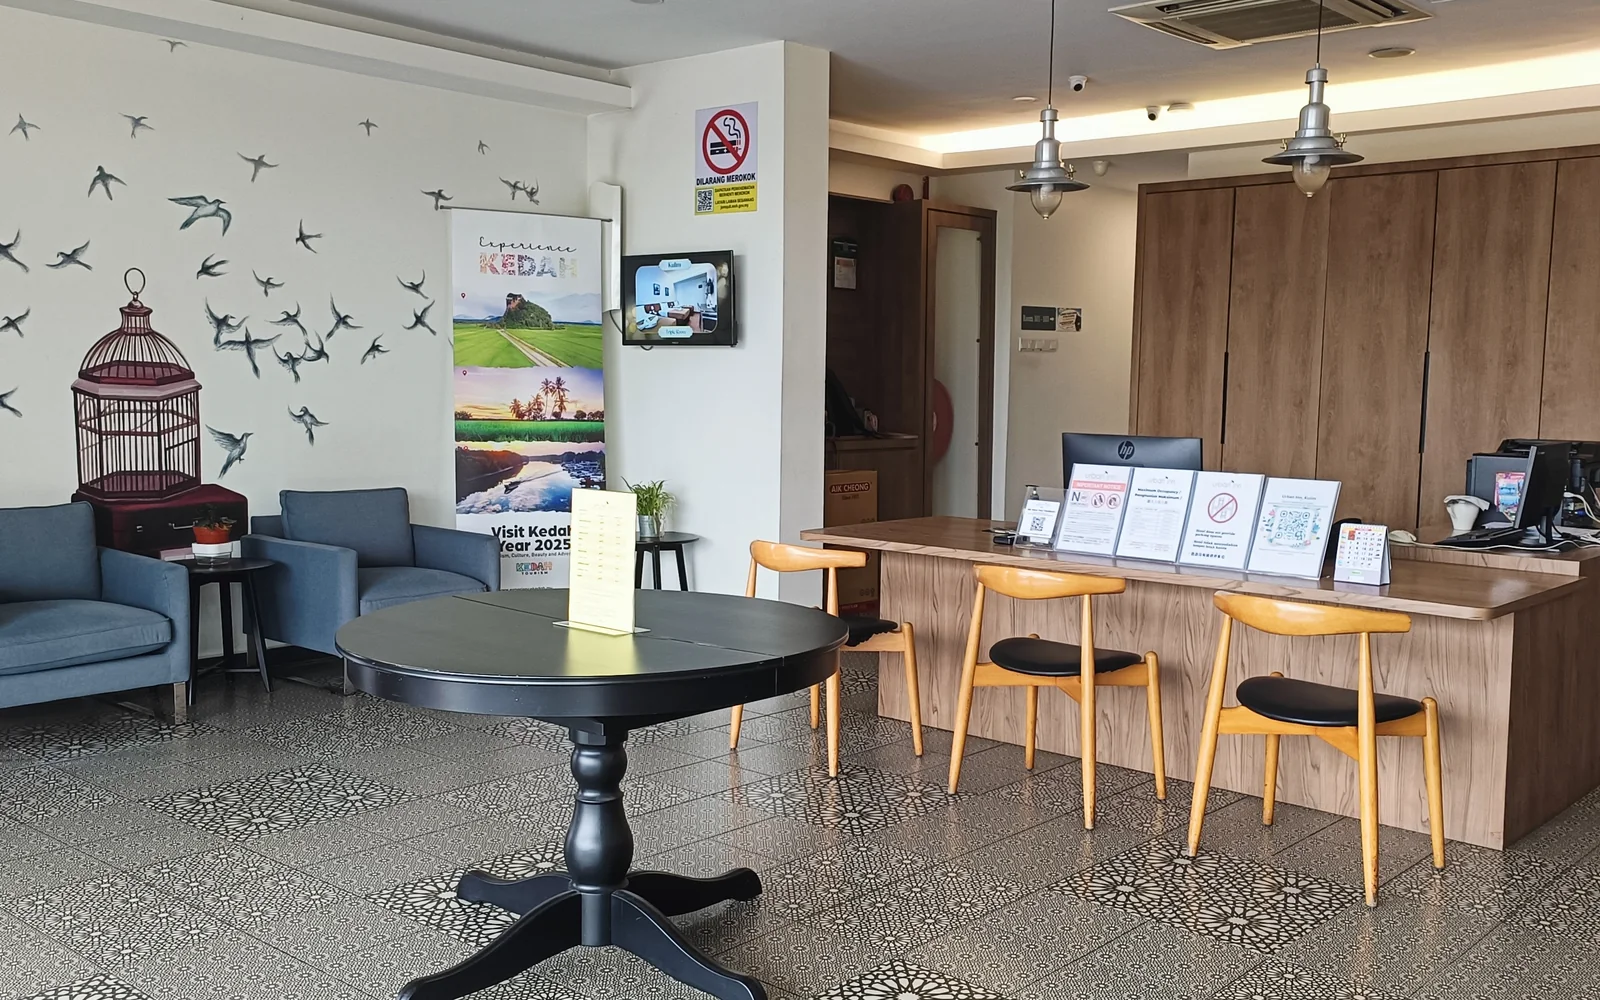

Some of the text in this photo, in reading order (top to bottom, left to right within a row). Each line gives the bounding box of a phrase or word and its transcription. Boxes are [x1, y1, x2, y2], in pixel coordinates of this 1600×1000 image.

[696, 172, 756, 186] DILARANG MEROKOK
[479, 236, 576, 252] Experience
[480, 252, 578, 278] KEDAH
[1120, 440, 1134, 460] hp
[831, 482, 869, 493] AIK CHEONG
[491, 525, 525, 538] Visit
[500, 538, 570, 552] Year 2025
[516, 562, 552, 572] KEDAH
